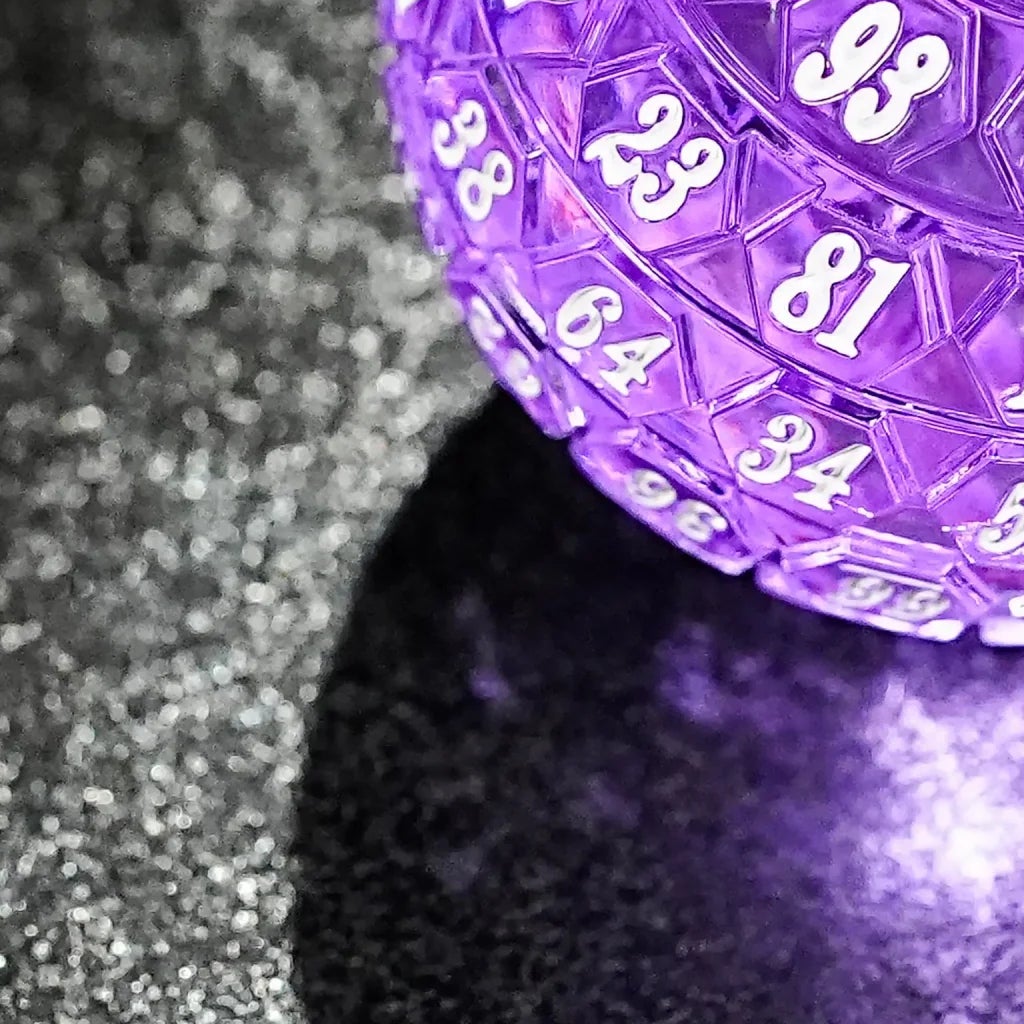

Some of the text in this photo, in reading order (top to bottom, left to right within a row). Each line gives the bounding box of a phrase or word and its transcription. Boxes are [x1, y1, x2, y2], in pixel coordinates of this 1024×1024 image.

[794, 0, 953, 144] 93
[432, 100, 513, 221] 38
[583, 93, 724, 222] 23
[555, 284, 671, 397] 64
[769, 233, 910, 358] 81
[737, 414, 871, 511] 34
